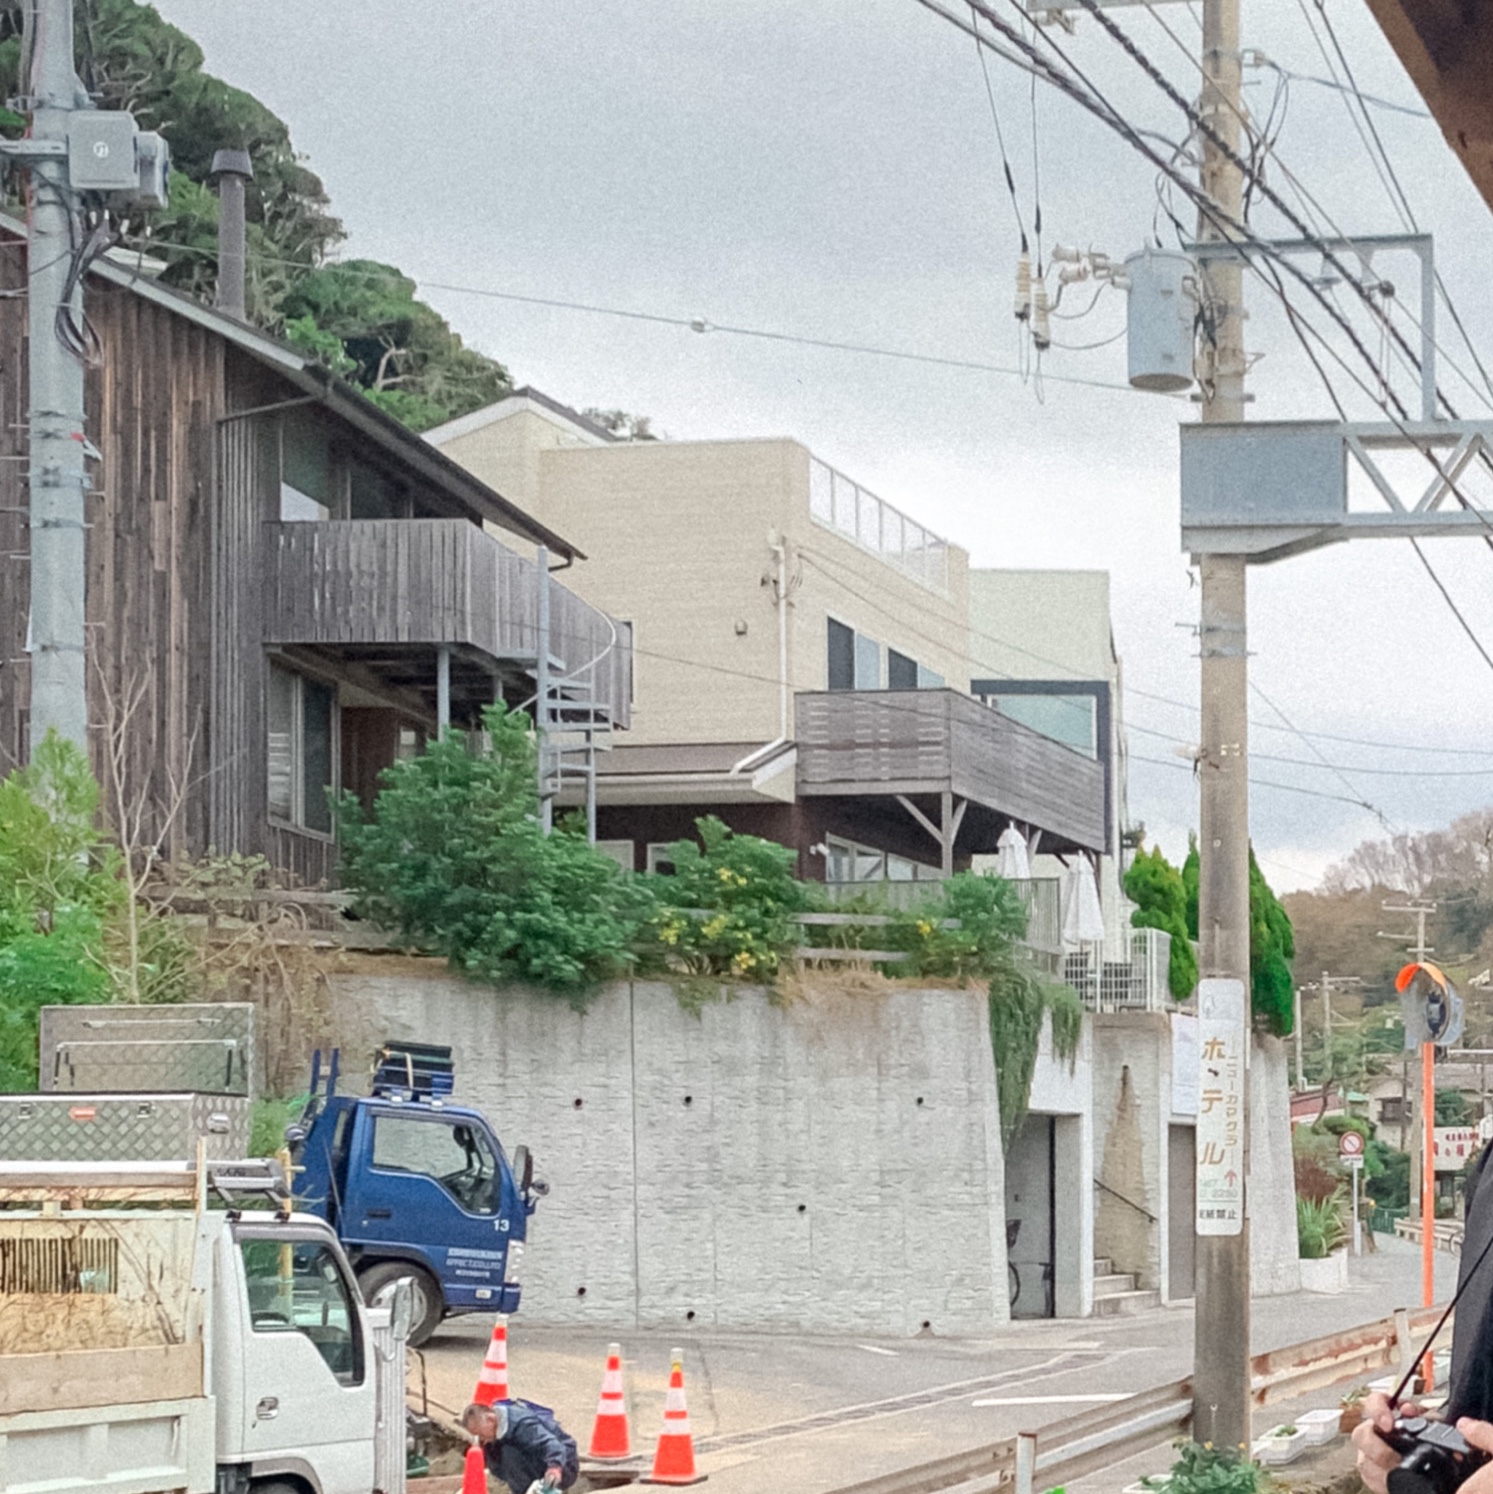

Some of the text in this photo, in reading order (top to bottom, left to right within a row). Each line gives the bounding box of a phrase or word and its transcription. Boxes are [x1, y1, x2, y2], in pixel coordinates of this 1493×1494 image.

[1200, 1036, 1227, 1165] ホテル
[493, 1219, 510, 1232] 13
